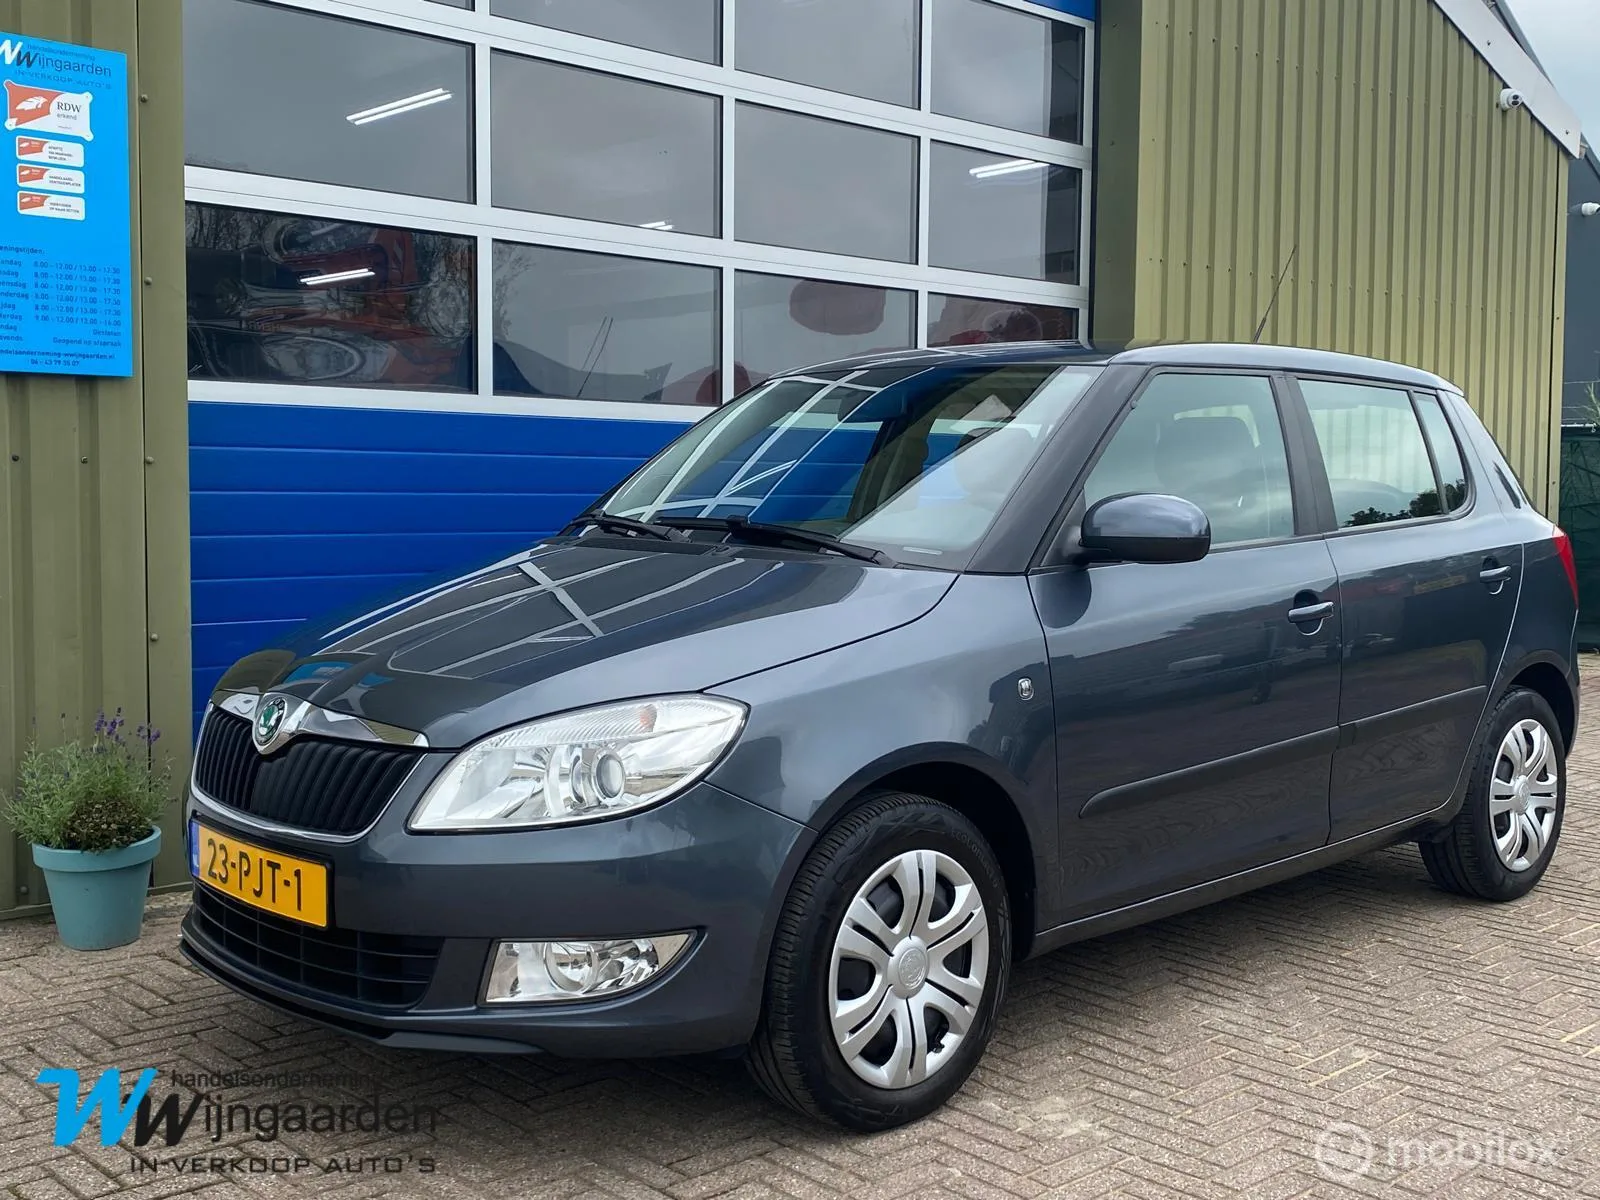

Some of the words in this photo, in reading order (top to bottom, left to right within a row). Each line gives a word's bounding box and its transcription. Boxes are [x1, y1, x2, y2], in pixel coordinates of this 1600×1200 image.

[57, 102, 82, 112] RDW
[56, 262, 73, 270] 12.00
[56, 273, 73, 281] 12.00
[56, 284, 73, 292] 12.00
[56, 294, 74, 302] 12.00
[56, 305, 74, 313] 12.00
[53, 337, 82, 346] Geopend
[207, 838, 303, 912] 23-PJT-1
